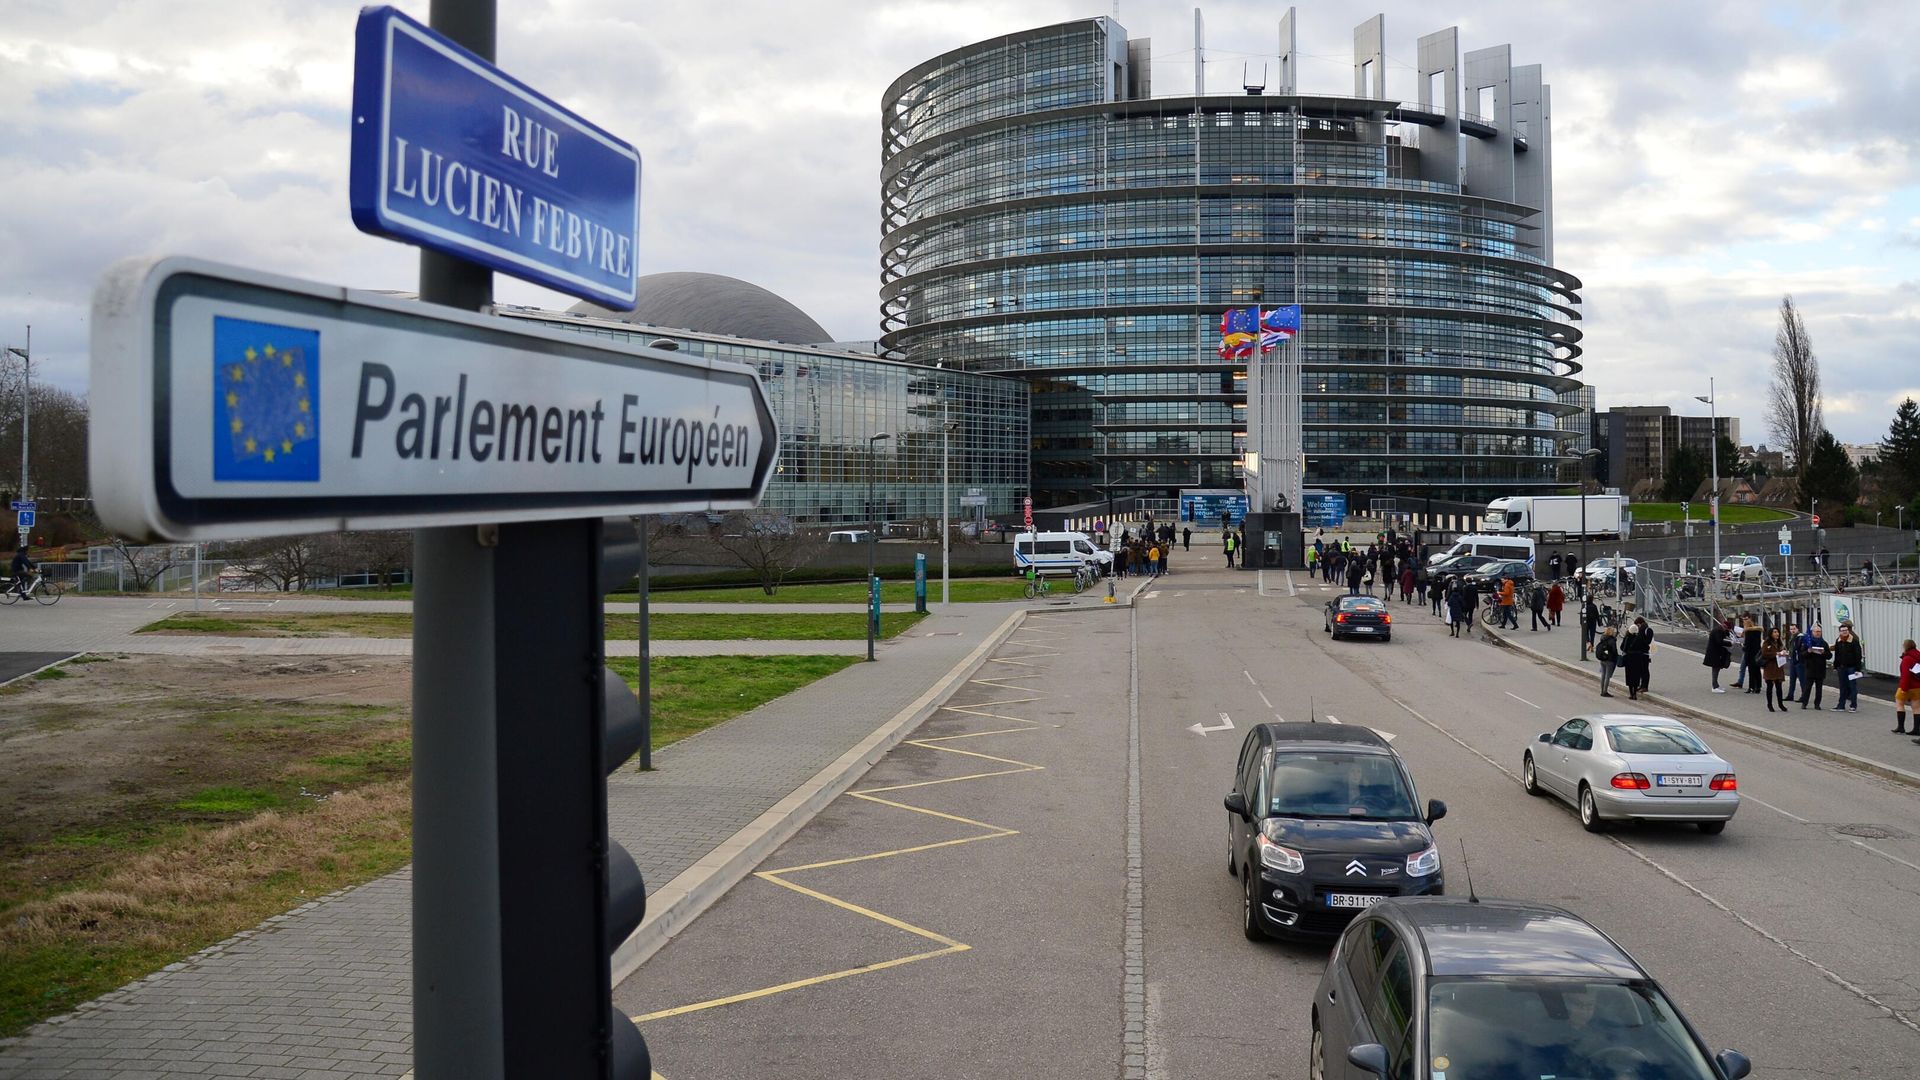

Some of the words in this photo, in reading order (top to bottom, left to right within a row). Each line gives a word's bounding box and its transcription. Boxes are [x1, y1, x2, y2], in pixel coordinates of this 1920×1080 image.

[501, 105, 559, 179] RUE
[394, 136, 523, 238] LUCIEN
[531, 196, 631, 278] FEBVRE
[351, 361, 605, 464] Parlement
[618, 394, 749, 484] Européen
